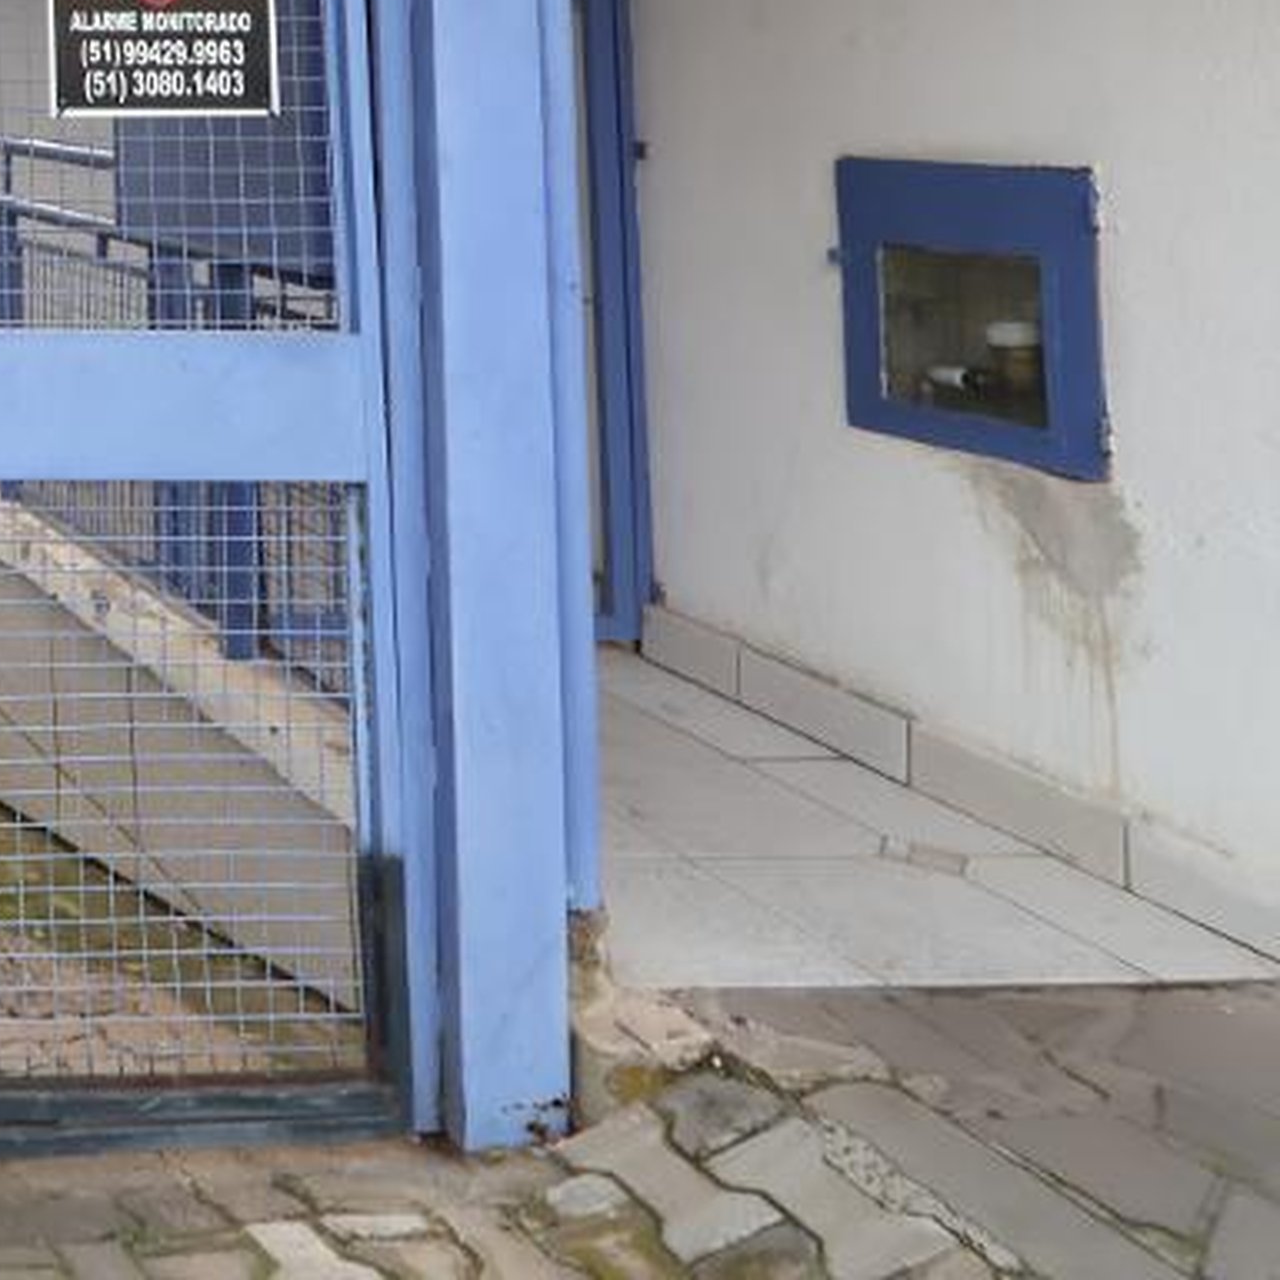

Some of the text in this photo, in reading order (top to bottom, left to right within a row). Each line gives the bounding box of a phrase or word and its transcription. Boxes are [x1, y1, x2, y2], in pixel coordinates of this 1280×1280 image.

[69, 11, 252, 33] ALARME MONITORADO
[84, 70, 246, 104] (51) 3080.1403
